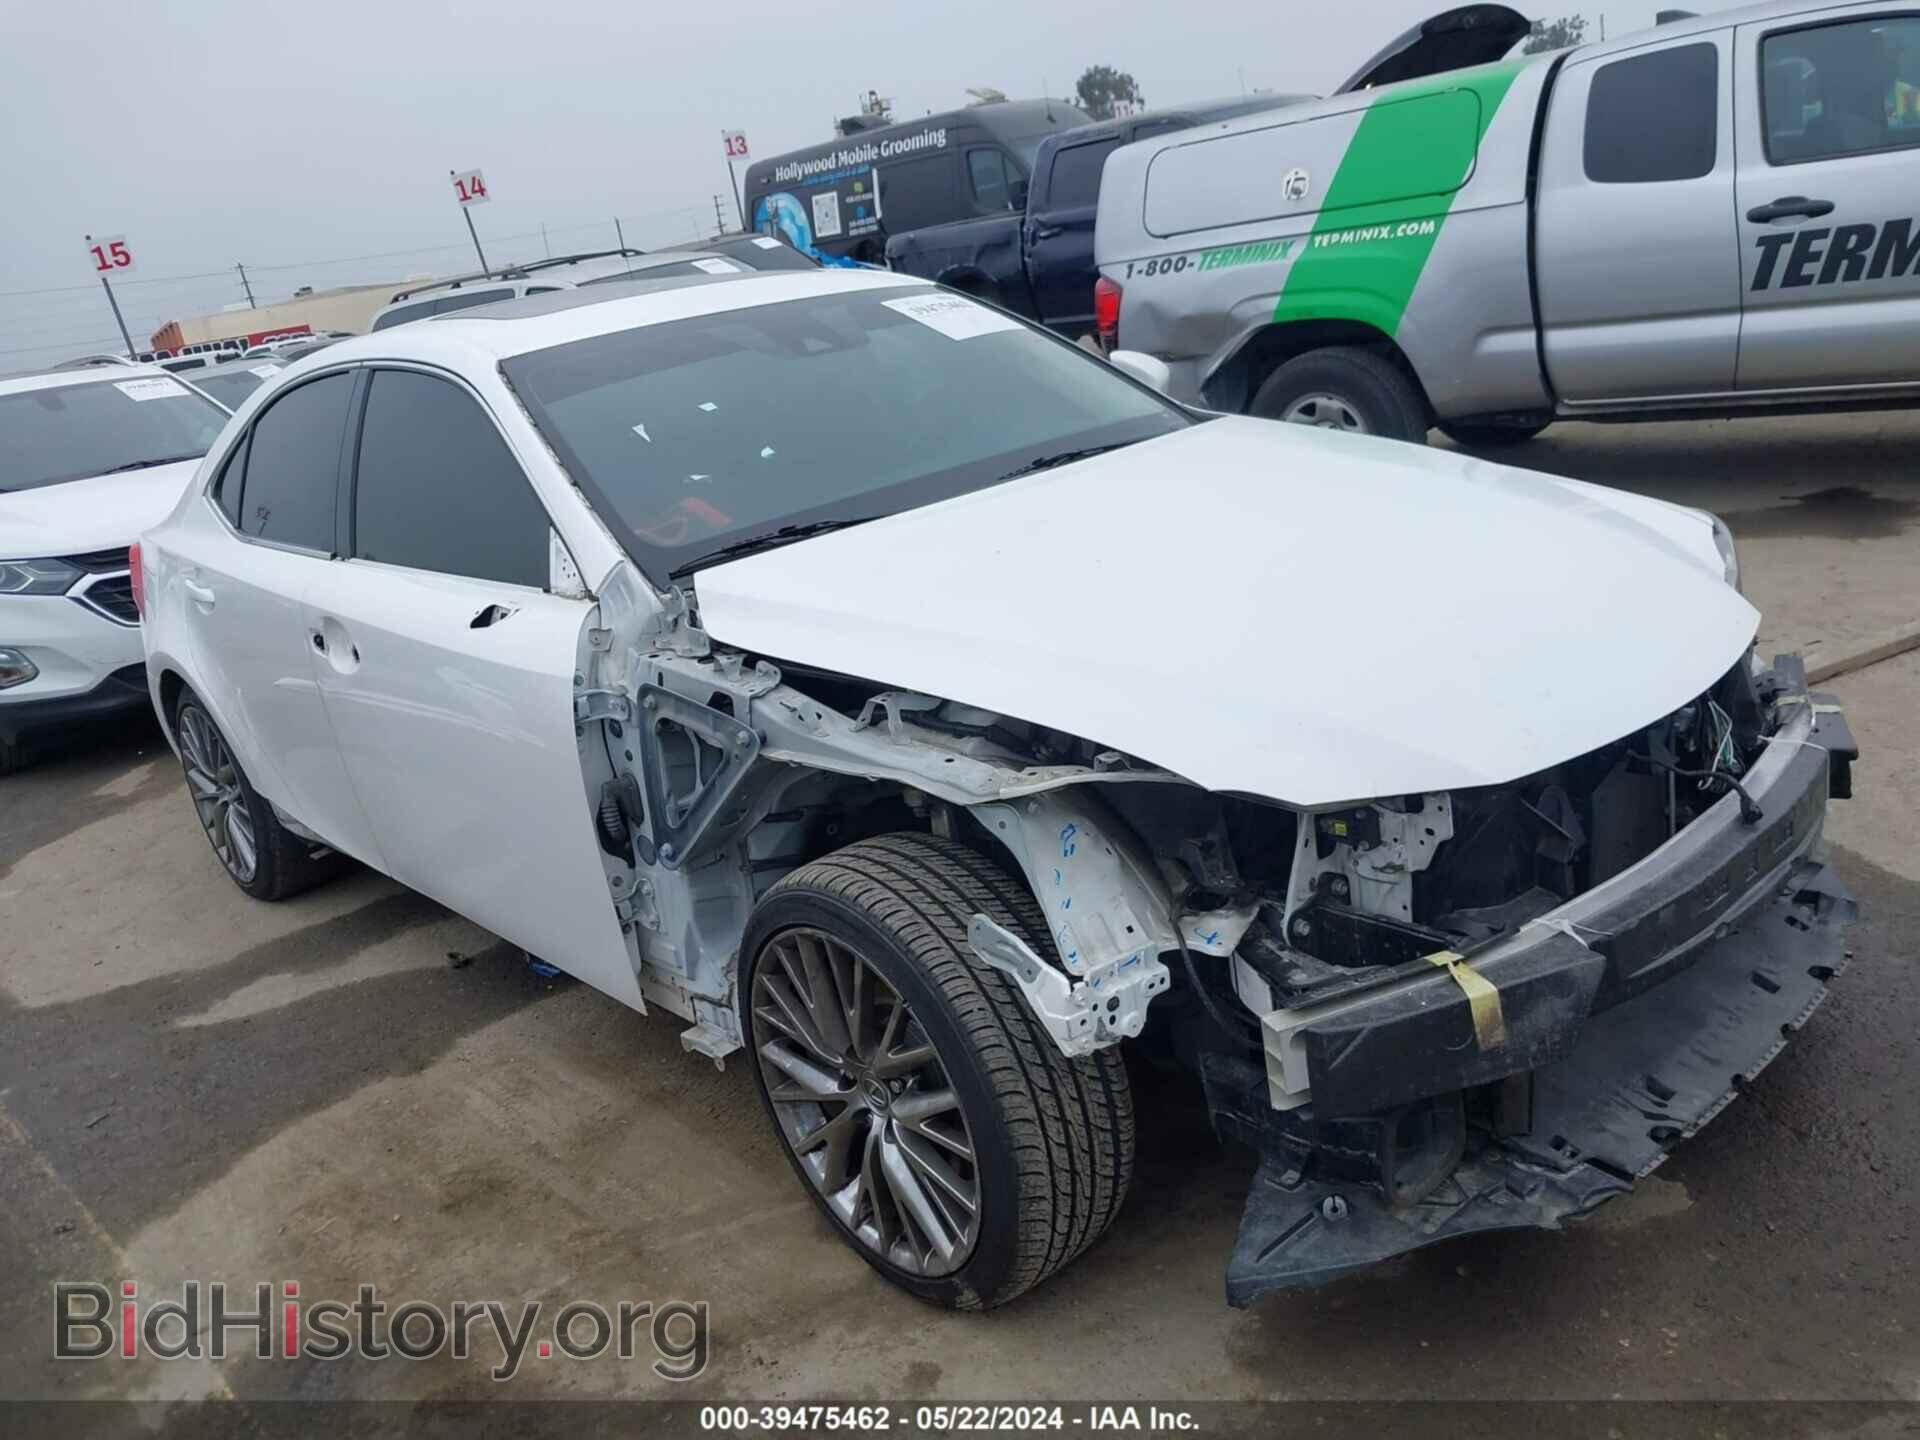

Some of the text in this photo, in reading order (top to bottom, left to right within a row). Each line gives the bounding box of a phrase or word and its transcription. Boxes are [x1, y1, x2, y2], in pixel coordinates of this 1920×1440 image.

[724, 136, 748, 155] 13
[775, 152, 836, 182] Hollywood
[838, 146, 878, 167] Mobile
[880, 128, 947, 157] Grooming
[454, 176, 486, 201] 14
[91, 241, 130, 271] 15
[1126, 240, 1296, 279] 1-800-TERMINIX
